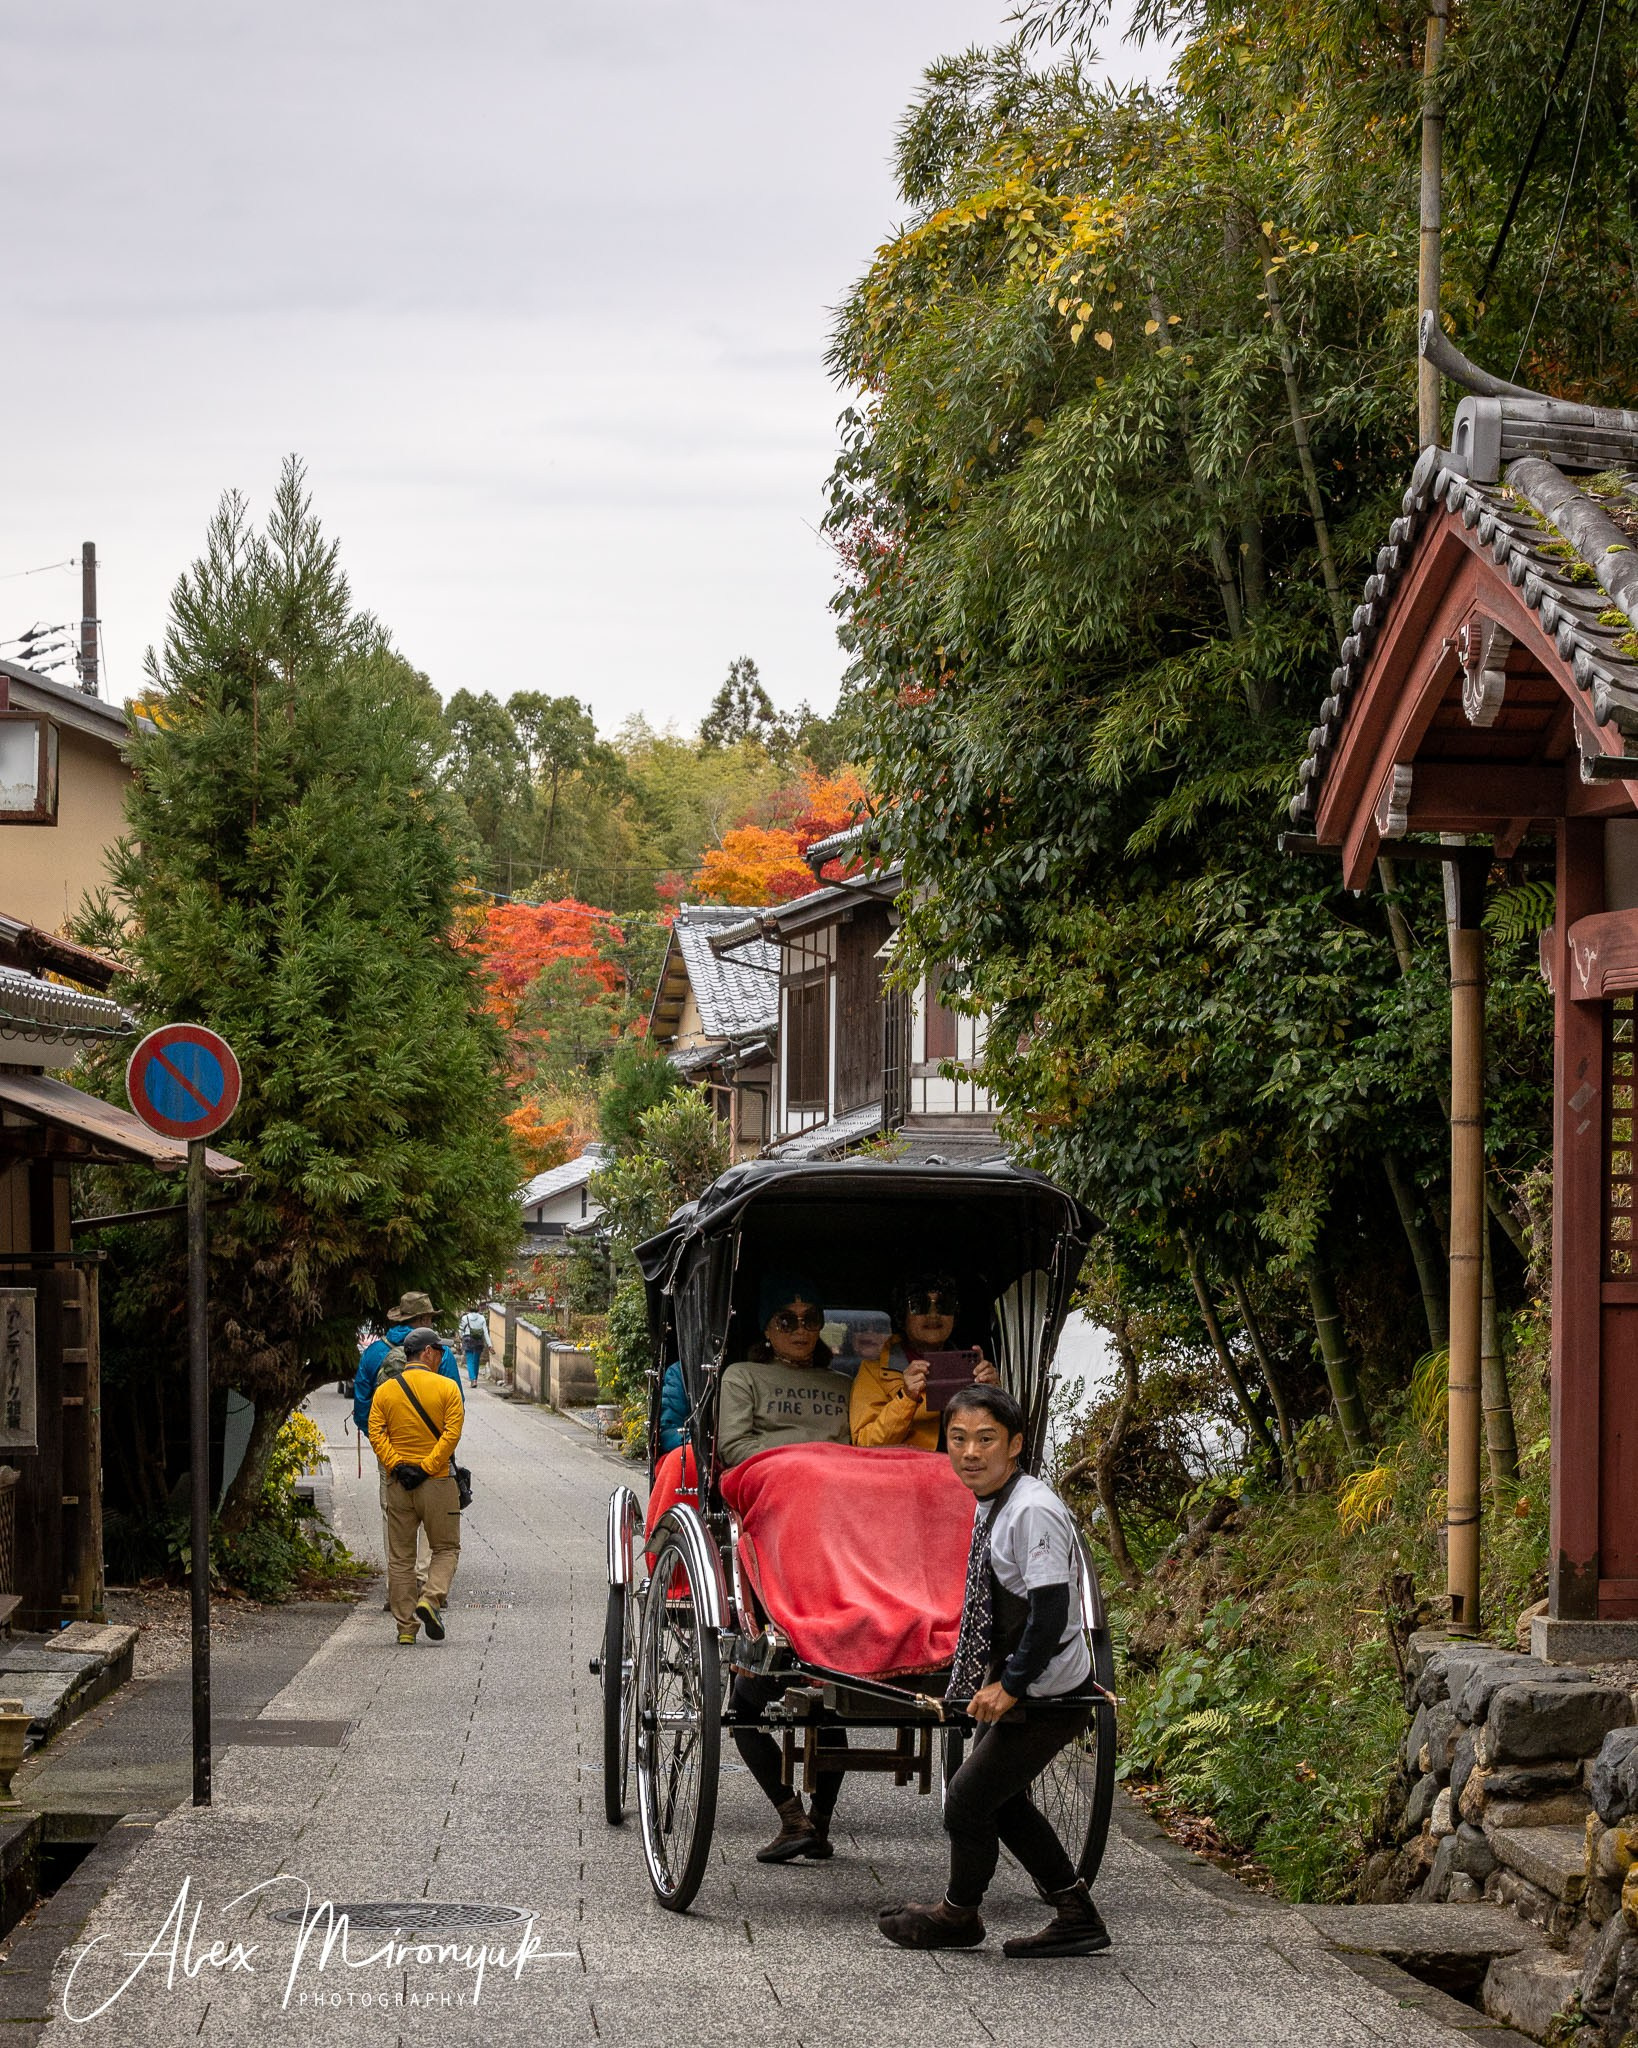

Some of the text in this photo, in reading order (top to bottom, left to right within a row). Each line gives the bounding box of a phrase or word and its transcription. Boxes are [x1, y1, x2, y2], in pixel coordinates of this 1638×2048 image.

[775, 1387, 846, 1404] PACIFICA
[766, 1400, 847, 1416] FIRE DEP
